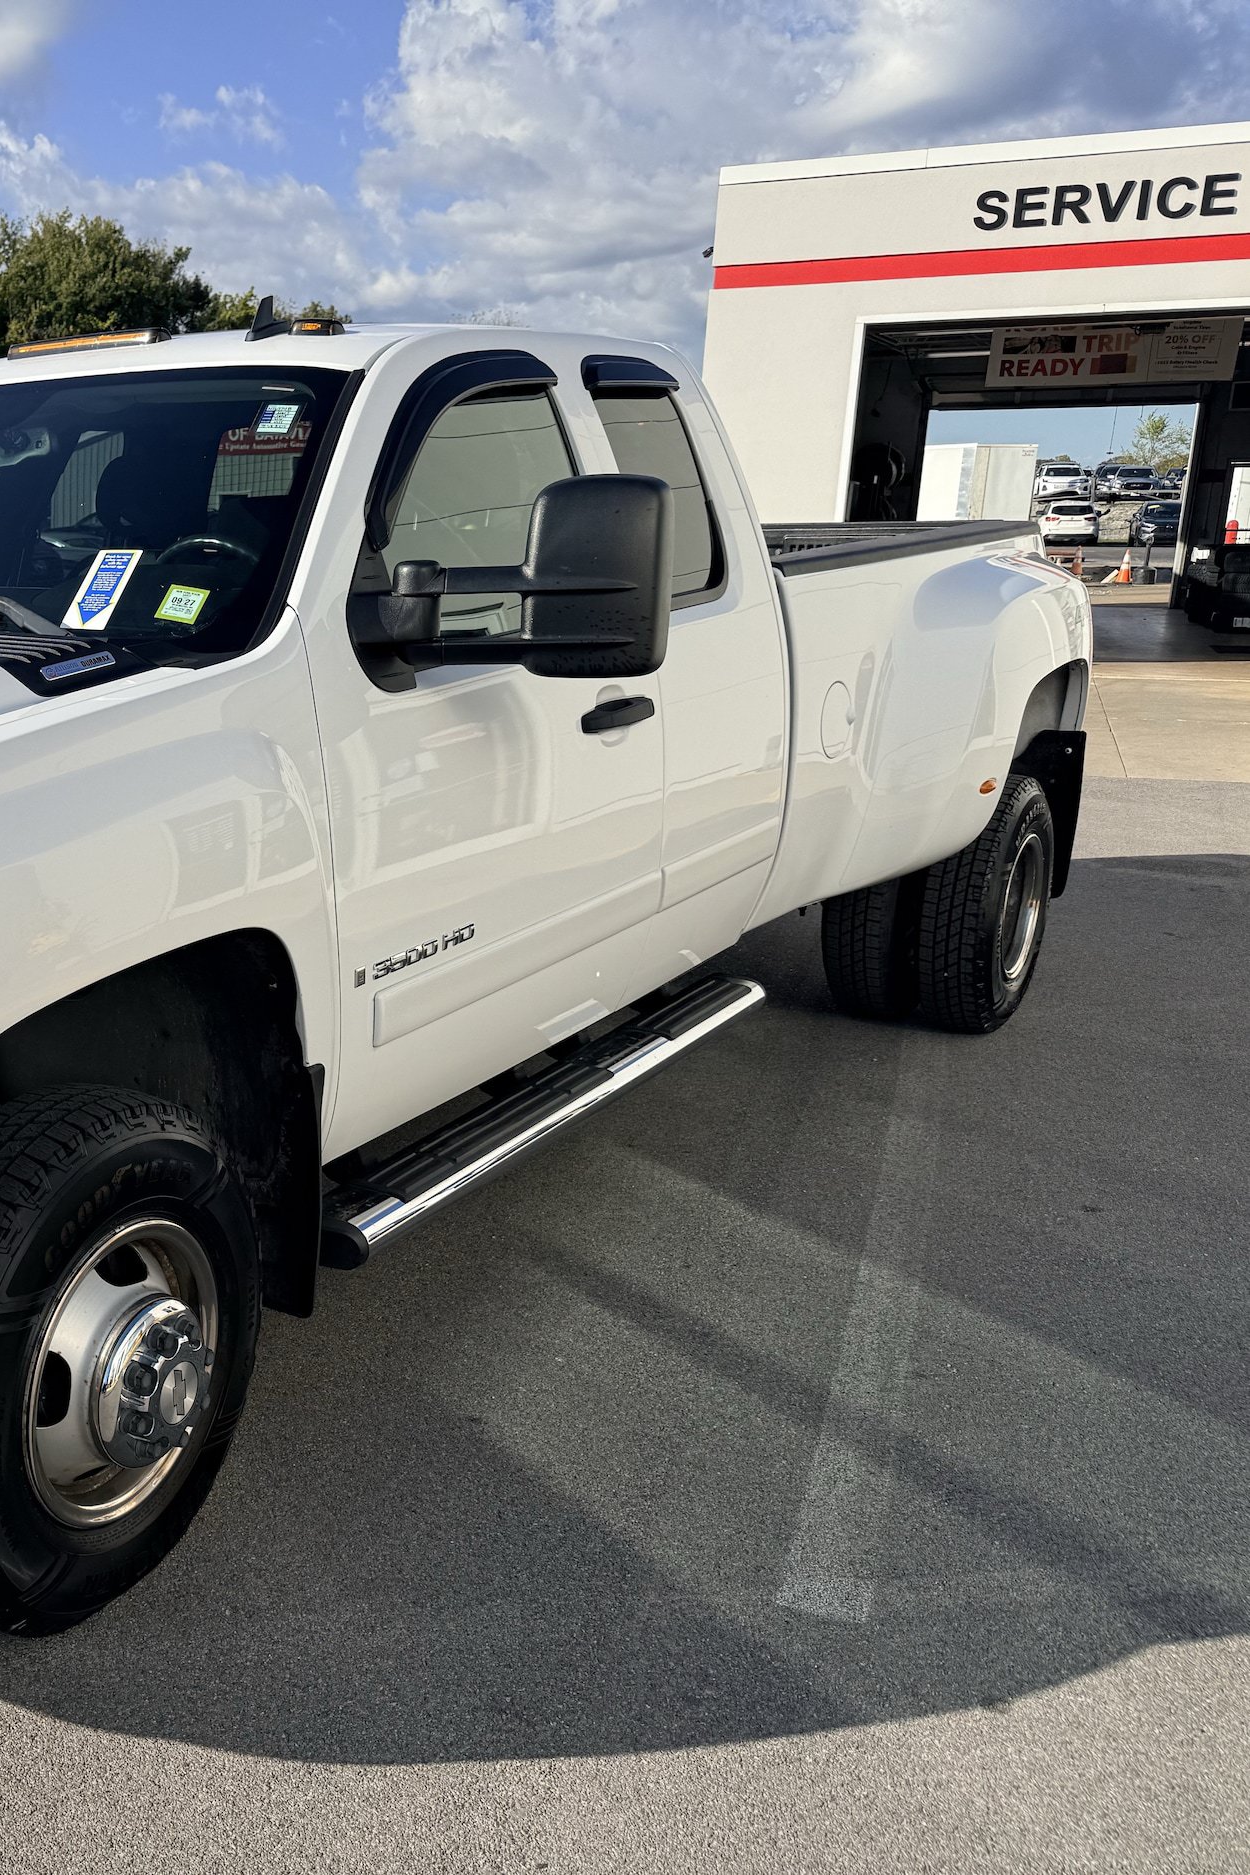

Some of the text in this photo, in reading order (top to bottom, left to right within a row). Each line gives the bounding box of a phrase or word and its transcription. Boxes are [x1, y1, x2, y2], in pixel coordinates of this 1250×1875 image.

[973, 173, 1241, 231] SERVICE
[1082, 332, 1140, 353] TRIP
[1165, 334, 1217, 345] 20% OFF
[999, 358, 1086, 377] READY
[171, 596, 196, 606] 09 27
[80, 654, 110, 667] DURAMAX
[372, 938, 438, 980] 3500
[442, 922, 475, 951] HD
